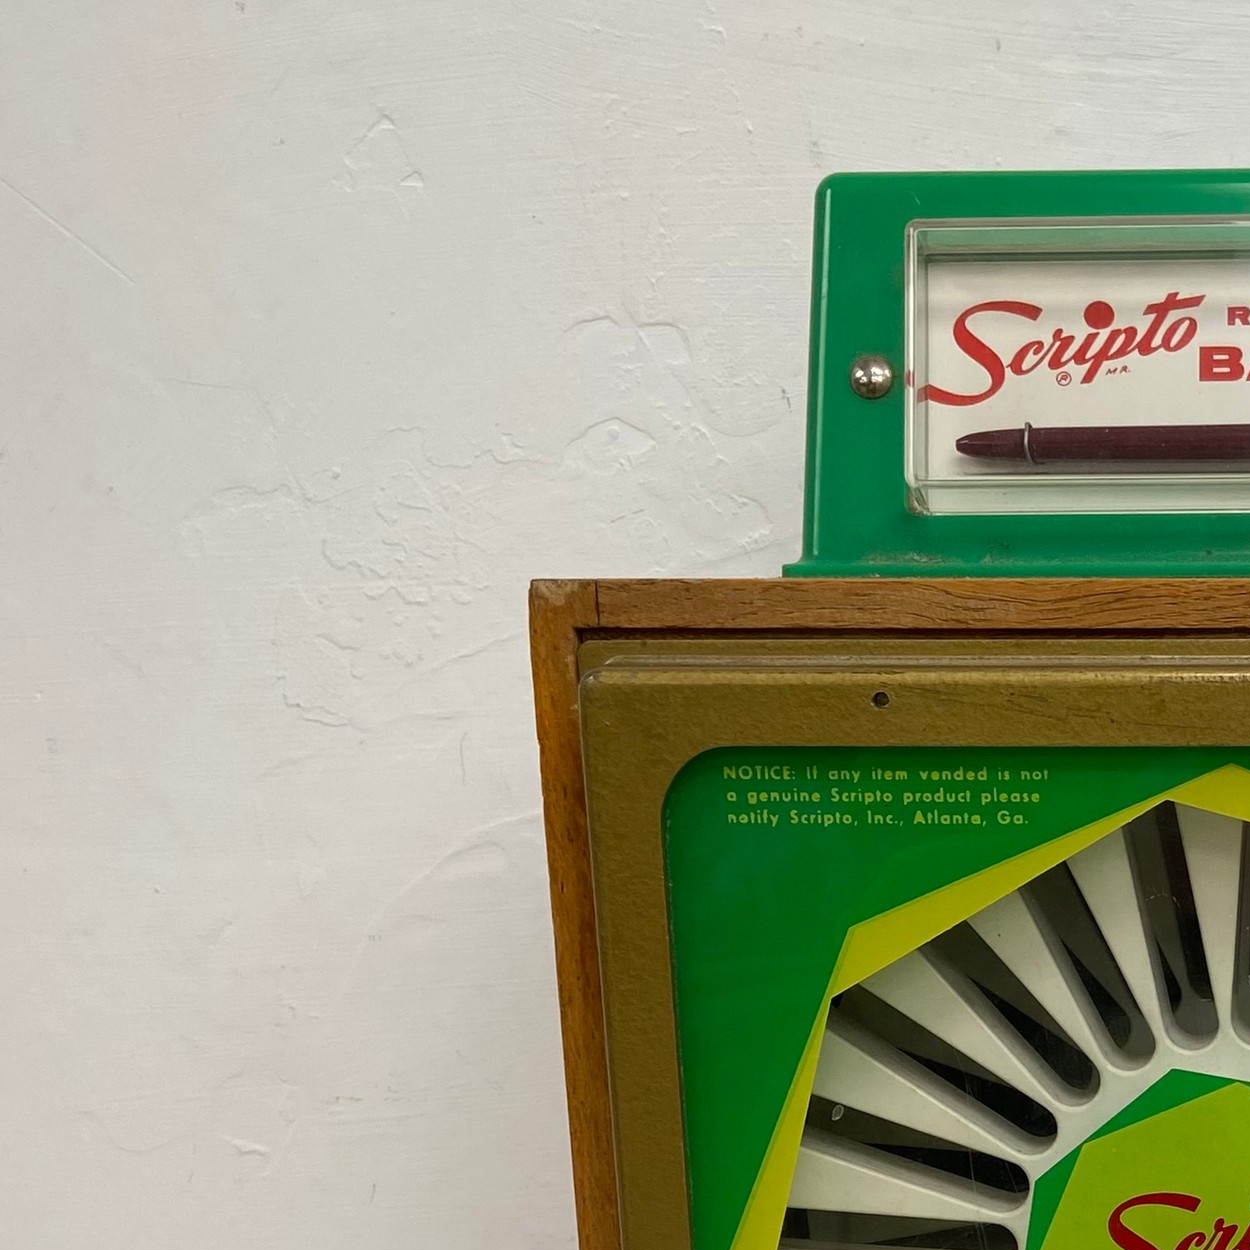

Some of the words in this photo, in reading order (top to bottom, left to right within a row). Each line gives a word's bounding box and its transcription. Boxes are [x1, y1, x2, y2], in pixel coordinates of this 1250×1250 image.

[917, 292, 1206, 406] Scripto
[723, 766, 795, 780] NOTICE:
[806, 766, 818, 779] If
[829, 769, 860, 783] any
[872, 767, 907, 780] item
[920, 768, 987, 781] vended
[998, 768, 1010, 781] is
[1021, 768, 1048, 780] not
[727, 791, 737, 802] a
[748, 789, 820, 804] genuine
[831, 789, 893, 804] Scripto
[903, 788, 970, 804] product
[981, 788, 1040, 805] please
[728, 810, 779, 826] notify
[790, 811, 858, 827] Scripto,
[868, 811, 903, 826] Inc.,
[914, 810, 986, 826] Atlanta,
[997, 811, 1028, 825] Ga.
